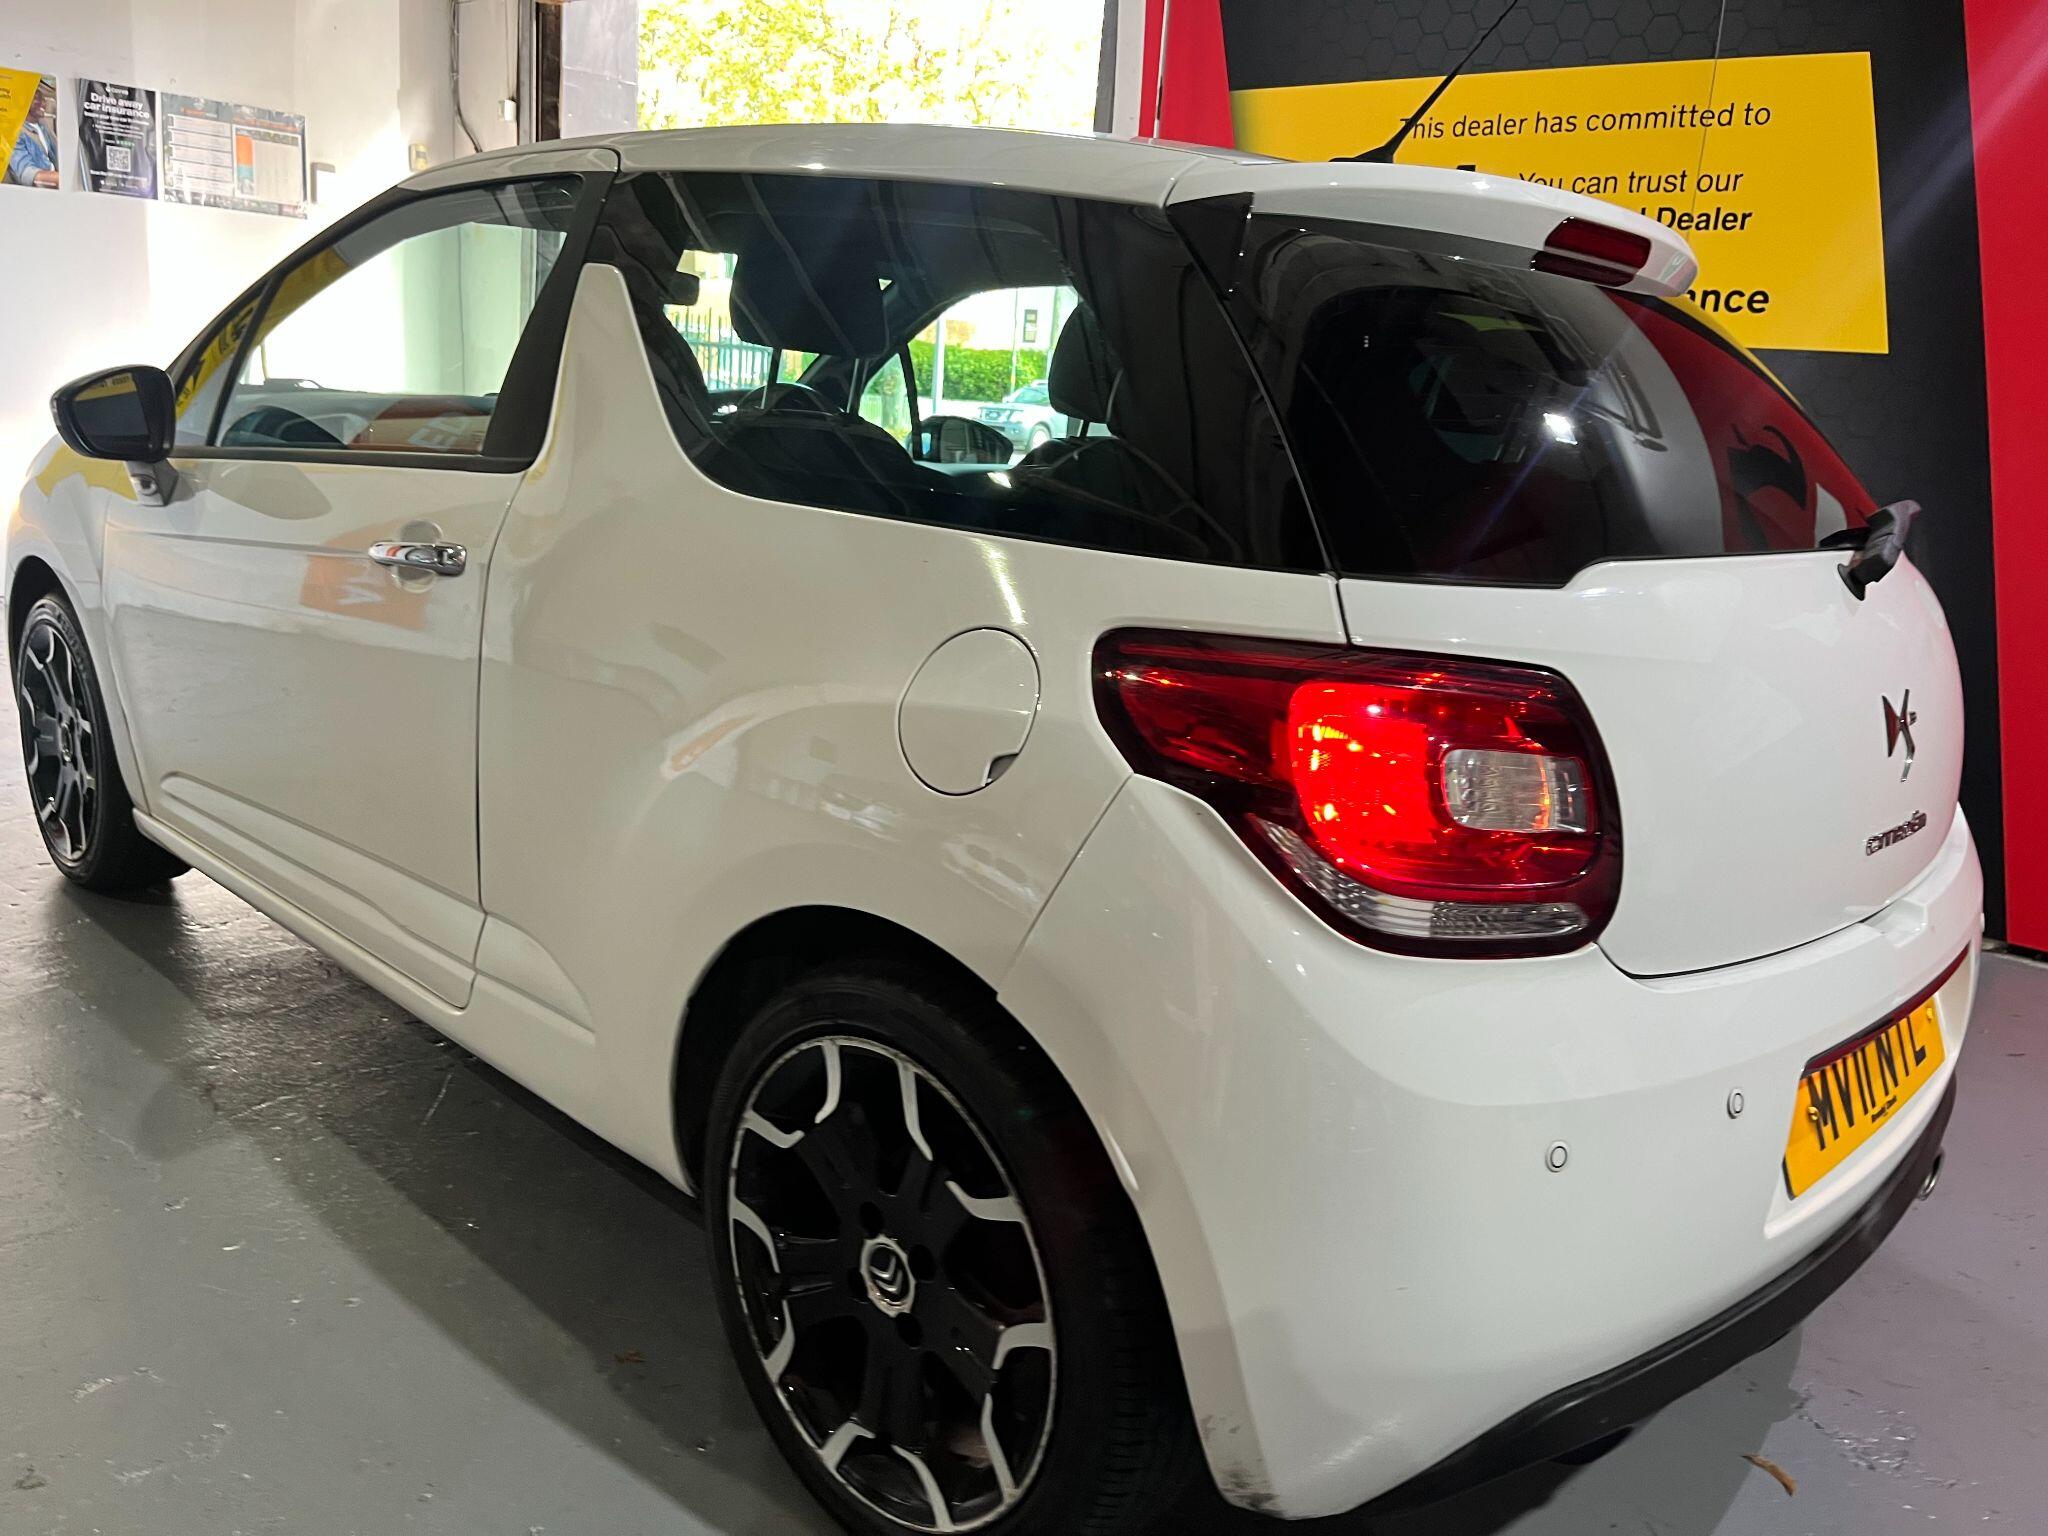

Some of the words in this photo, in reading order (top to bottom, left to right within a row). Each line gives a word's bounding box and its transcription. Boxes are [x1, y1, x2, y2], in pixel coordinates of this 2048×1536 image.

[84, 102, 101, 110] car
[102, 103, 149, 118] insurance
[91, 92, 117, 105] Drive
[118, 98, 143, 110] away
[1452, 112, 1528, 137] dealer
[1534, 111, 1577, 133] has
[1586, 102, 1735, 131] committed
[1744, 102, 1771, 126] to
[1572, 175, 1618, 194] can
[1628, 169, 1688, 194] trust
[1696, 173, 1744, 193] our
[1656, 206, 1753, 231] Dealer
